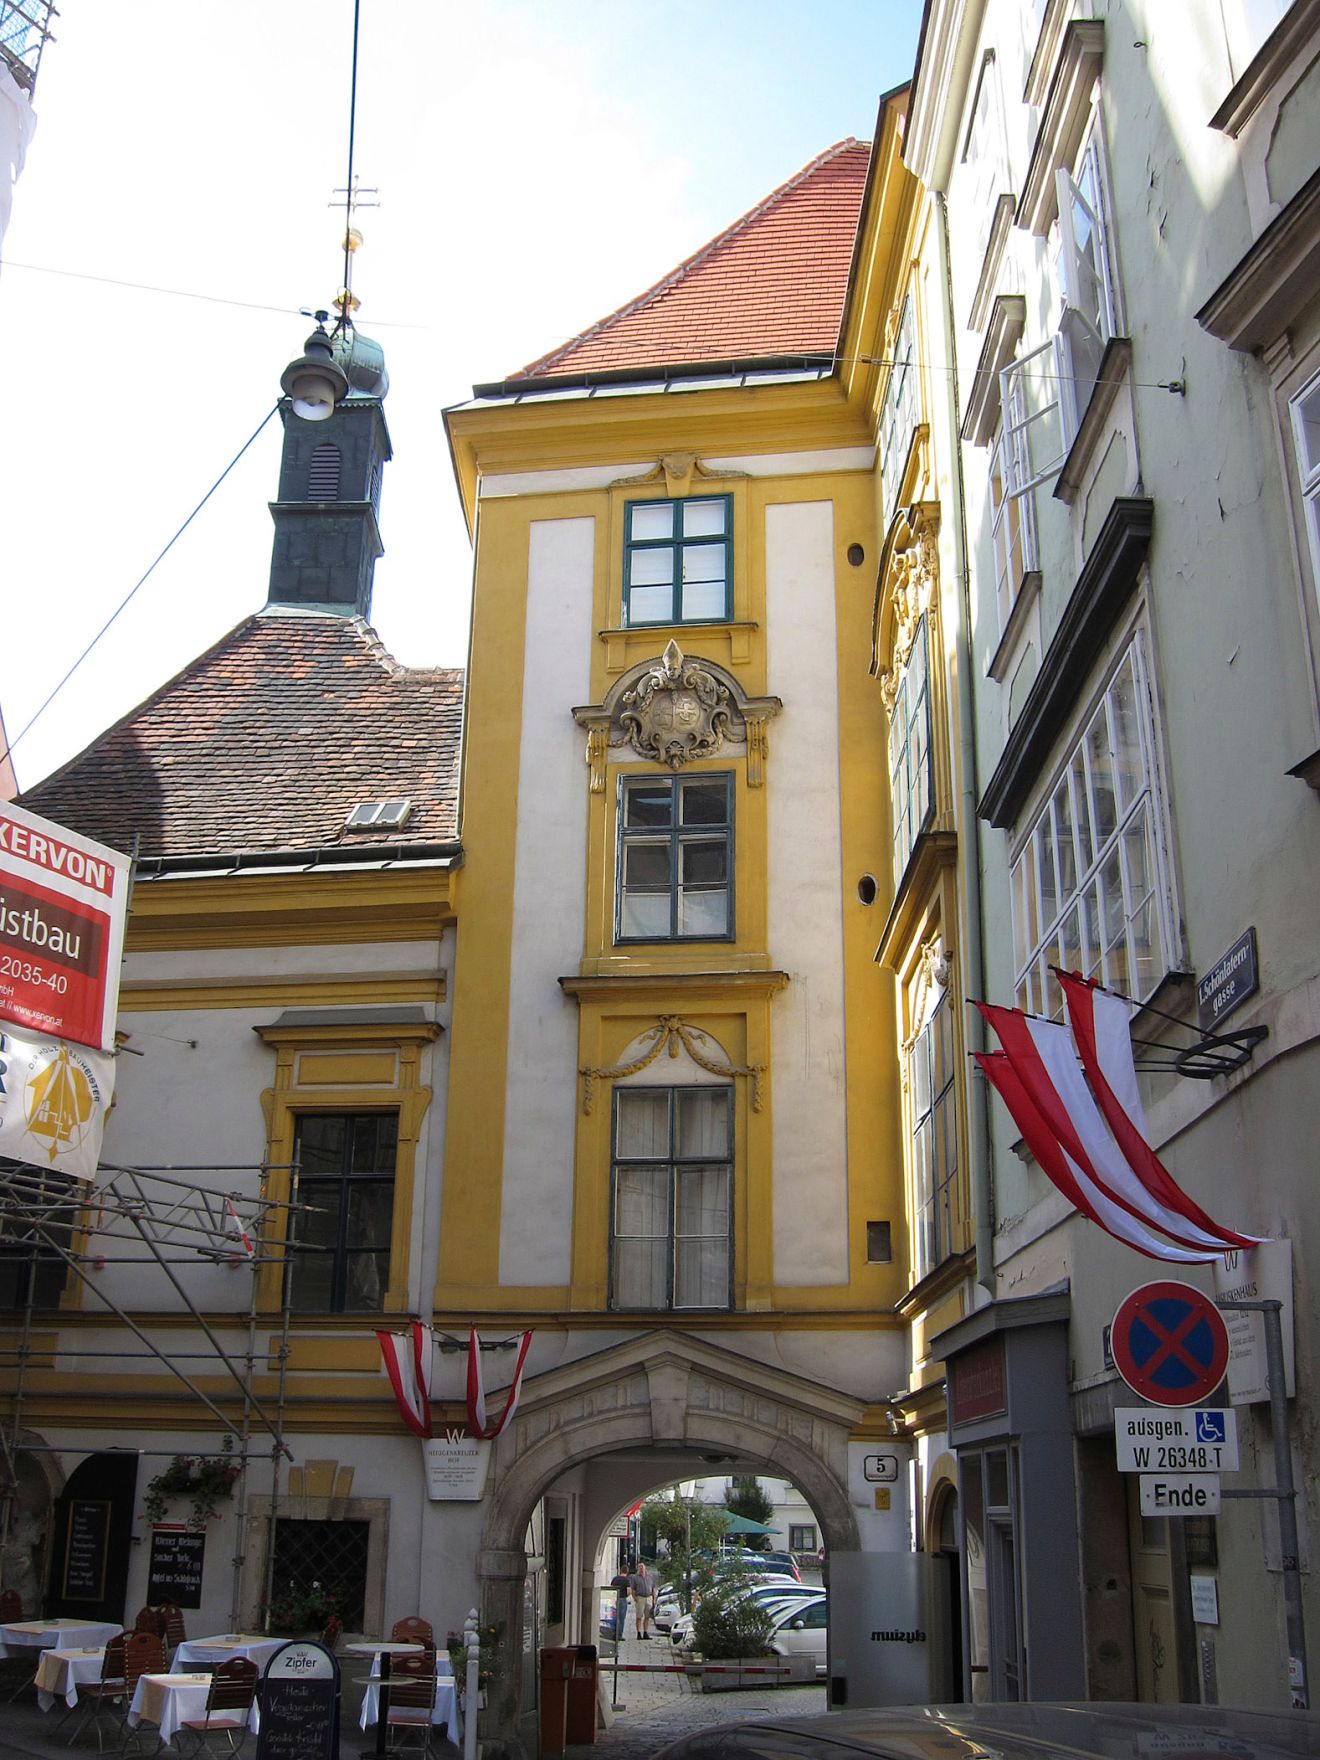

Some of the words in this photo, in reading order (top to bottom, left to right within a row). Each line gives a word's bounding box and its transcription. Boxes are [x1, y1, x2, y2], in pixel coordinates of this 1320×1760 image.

[1213, 980, 1236, 1017] gasse
[1127, 1419, 1189, 1440] ausgen.
[876, 1458, 886, 1473] 5
[1133, 1447, 1150, 1468] W
[1158, 1447, 1207, 1468] 26348
[1213, 1448, 1222, 1468] T
[1154, 1483, 1207, 1507] Ende
[285, 1657, 317, 1669] Zipfer
